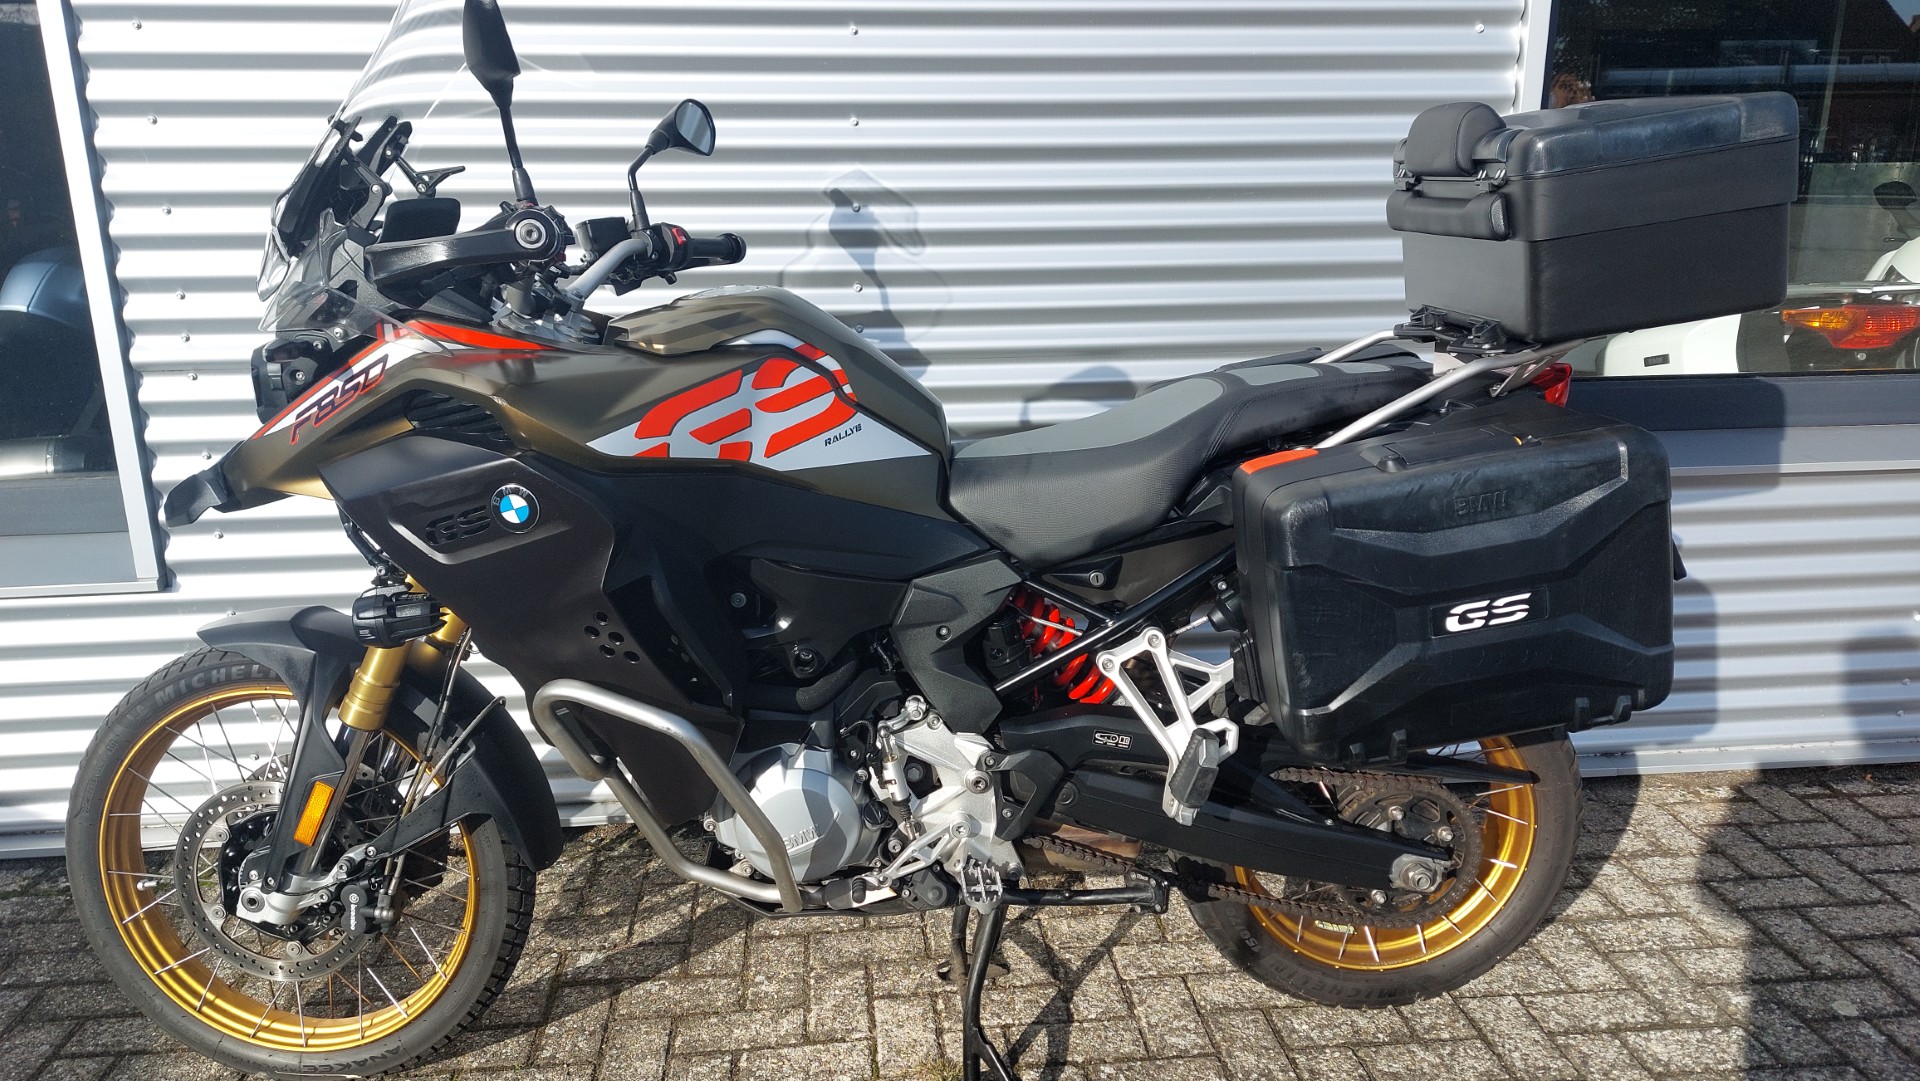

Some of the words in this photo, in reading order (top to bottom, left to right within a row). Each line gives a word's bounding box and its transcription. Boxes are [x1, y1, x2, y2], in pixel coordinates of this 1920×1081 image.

[291, 353, 389, 445] F850
[824, 423, 862, 447] RALLYE
[492, 486, 529, 506] BMW
[425, 505, 491, 545] GS
[1446, 592, 1532, 632] GS
[154, 664, 278, 707] MICHELI
[302, 1045, 401, 1073] ANAKEE
